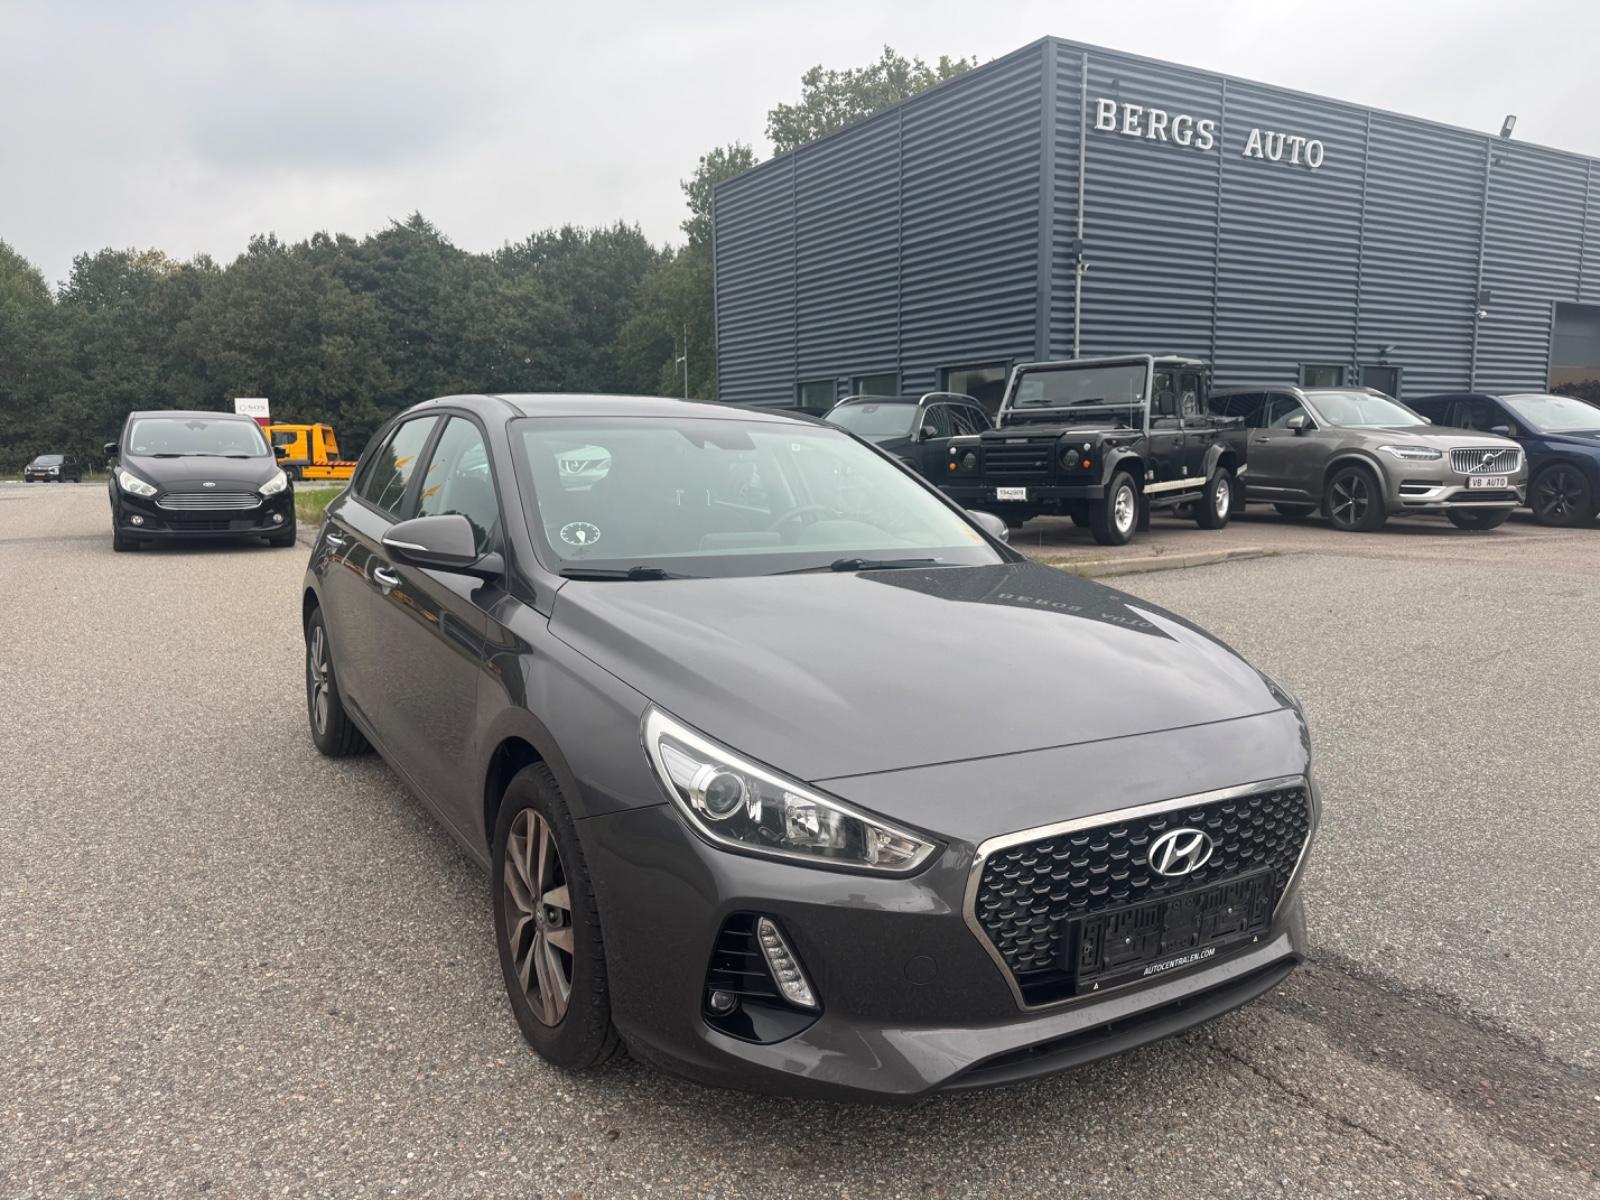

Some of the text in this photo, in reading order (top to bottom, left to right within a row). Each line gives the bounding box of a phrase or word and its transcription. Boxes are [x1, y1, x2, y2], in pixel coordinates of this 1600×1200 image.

[1094, 98, 1324, 168] BERGS AUTO
[1487, 478, 1505, 487] AUTO
[1143, 947, 1216, 976] AUTOCENTRALEN.COM
